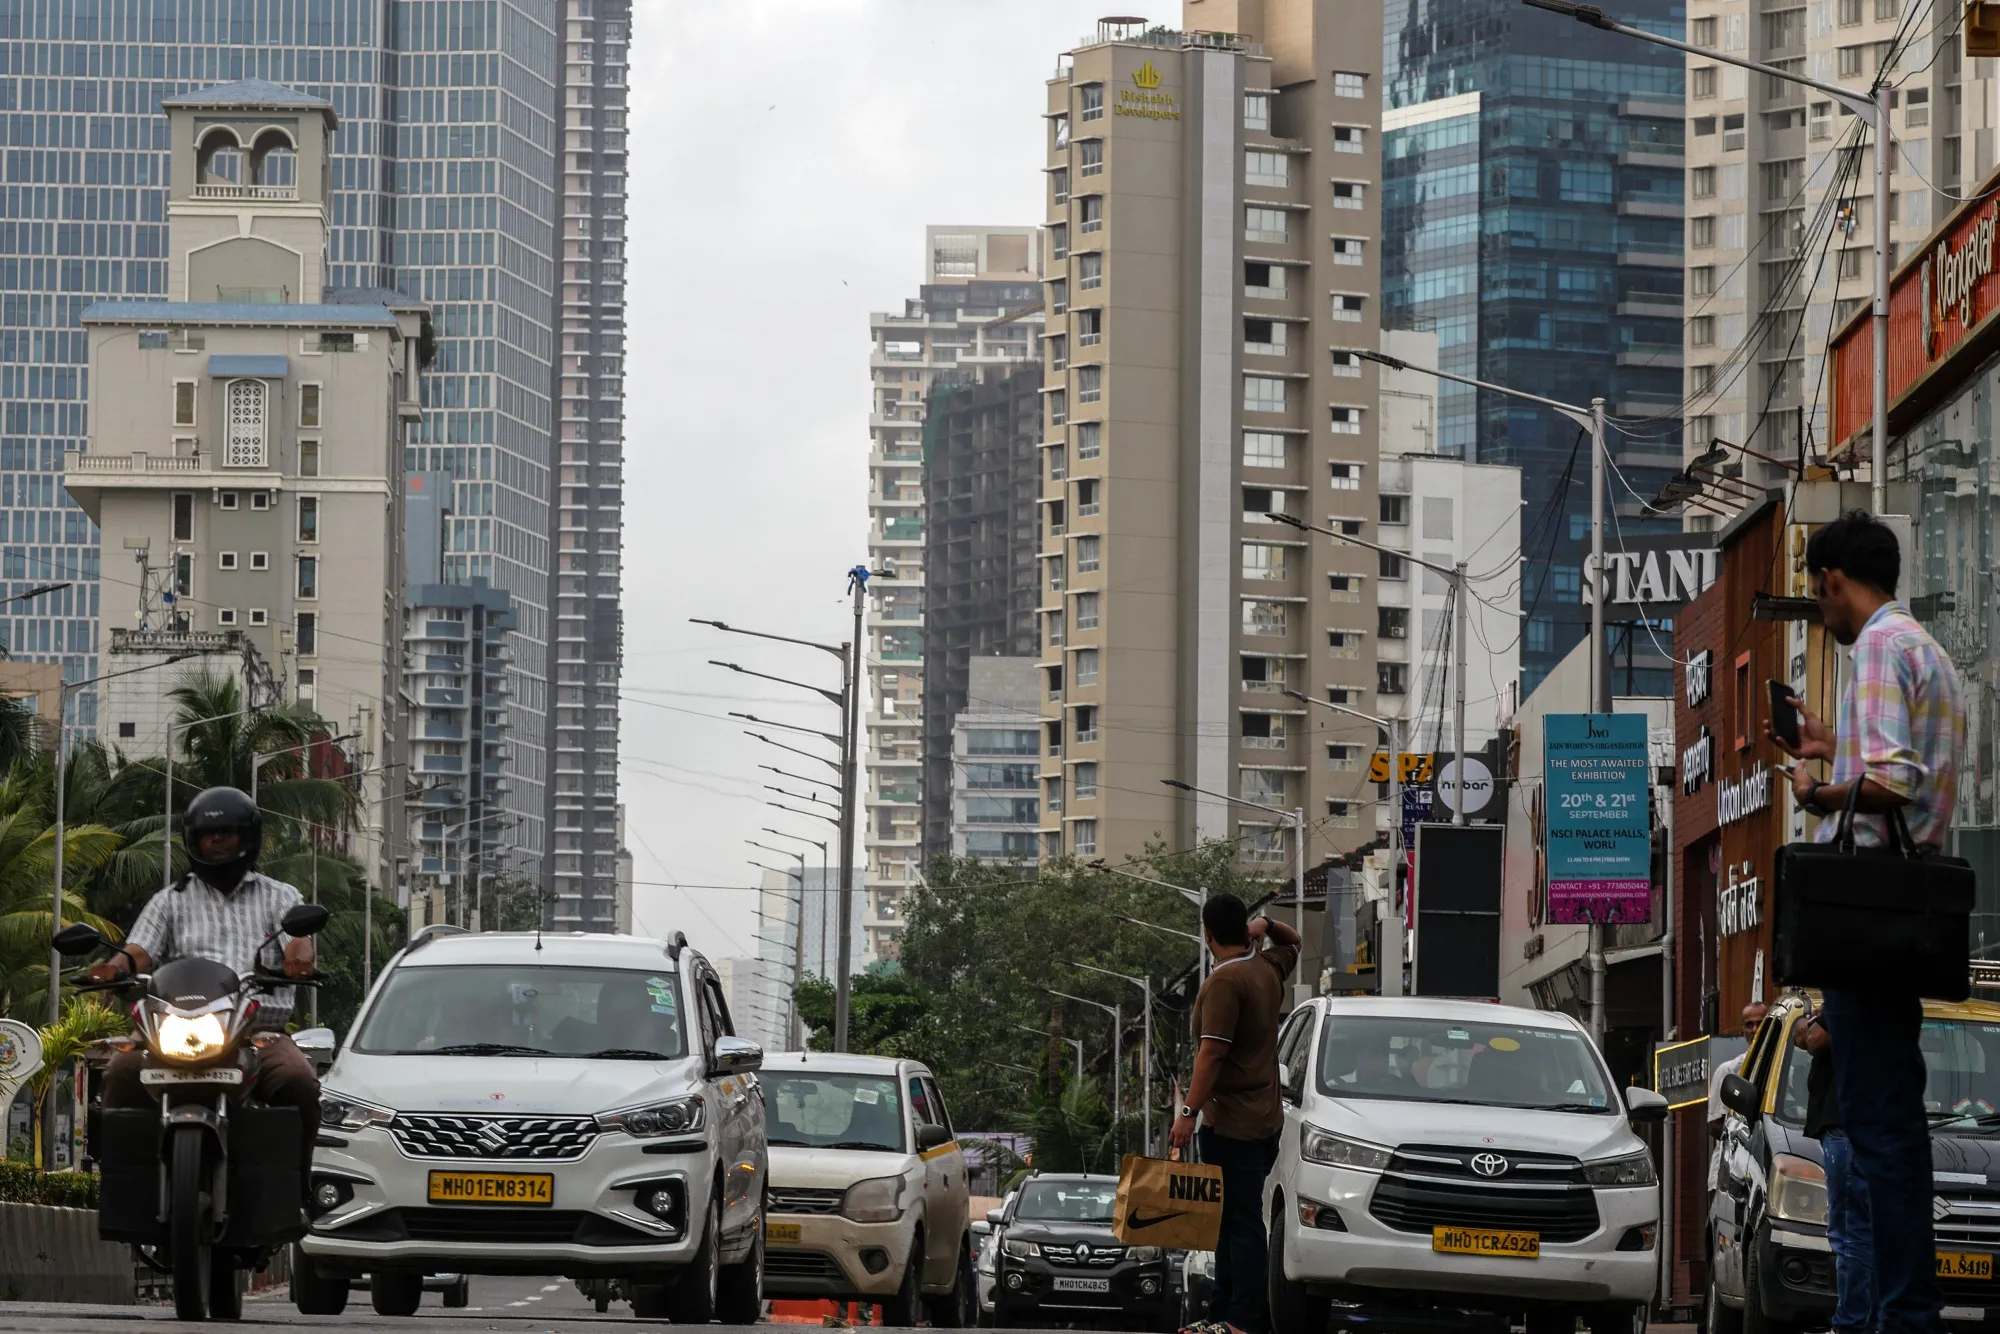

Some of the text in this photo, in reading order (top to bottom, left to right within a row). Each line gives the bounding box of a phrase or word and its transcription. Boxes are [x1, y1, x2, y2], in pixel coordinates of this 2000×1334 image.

[1121, 90, 1174, 105] Rishabh
[1114, 104, 1180, 120] Developers
[1937, 216, 1996, 328] Manyavar
[1595, 742, 1645, 750] ORGANISATION
[1550, 759, 1644, 768] THE MOST AWAITED
[1571, 771, 1625, 780] EXHIBITION
[1442, 781, 1488, 790] nbar
[1717, 759, 1768, 827] Urban Ladder
[1560, 793, 1636, 808] 20th & 21st
[1569, 810, 1628, 819] SEPTEMBER
[1551, 829, 1646, 840] NSCI PALACE HALLS,
[1583, 840, 1616, 850] WORLI
[1551, 882, 1582, 890] CONTACT
[1606, 882, 1648, 890] 7738050442
[443, 1177, 547, 1198] MH01EM8314
[1169, 1174, 1221, 1203] NIKE
[1444, 1231, 1537, 1252] MH01CR4926
